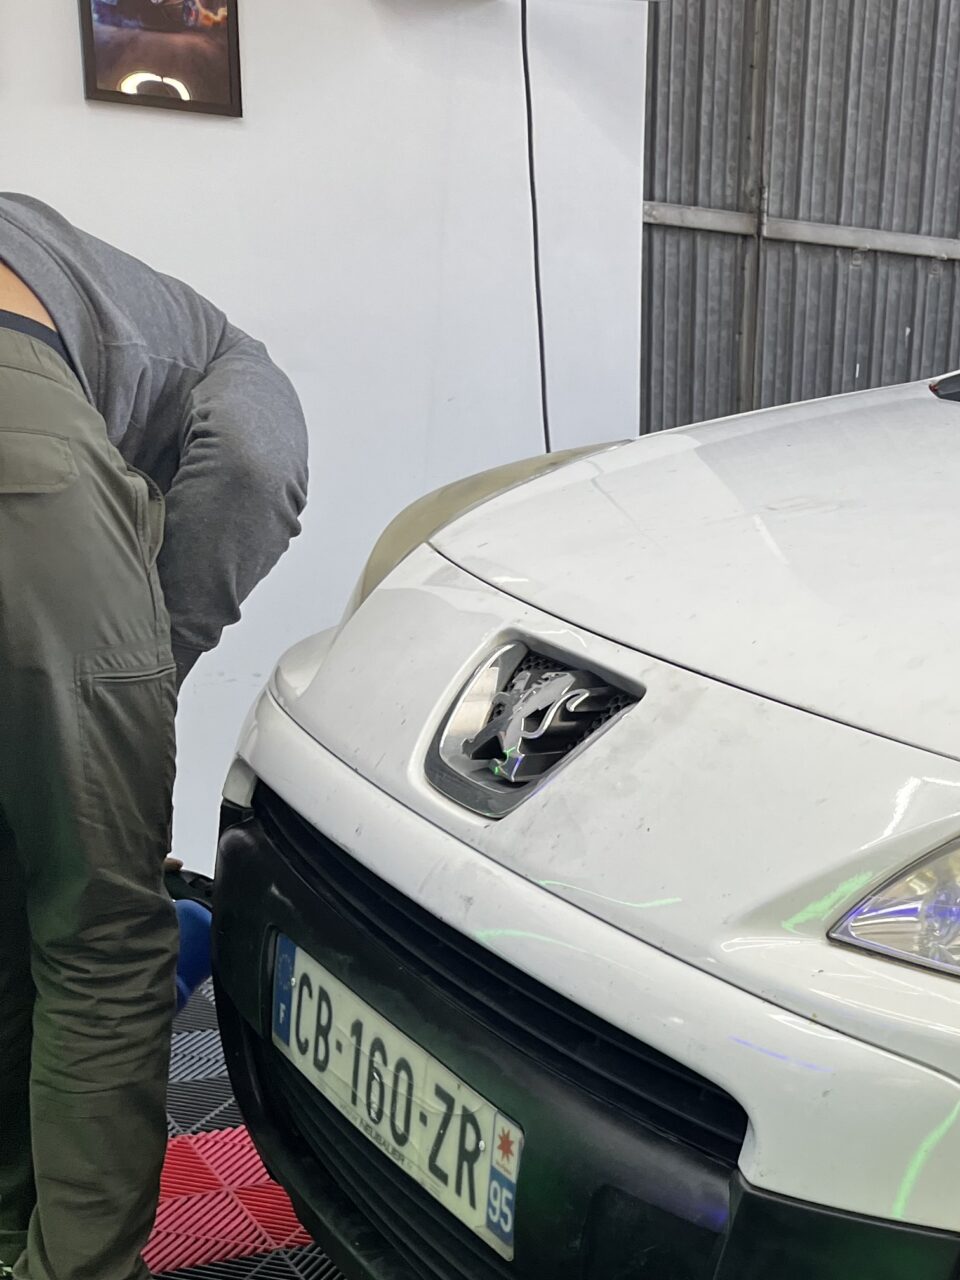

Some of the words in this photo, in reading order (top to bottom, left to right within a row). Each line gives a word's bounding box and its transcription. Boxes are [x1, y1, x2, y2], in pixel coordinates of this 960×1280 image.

[279, 1002, 287, 1024] F
[296, 973, 482, 1210] CB-160-ZR
[488, 1180, 514, 1233] 95
